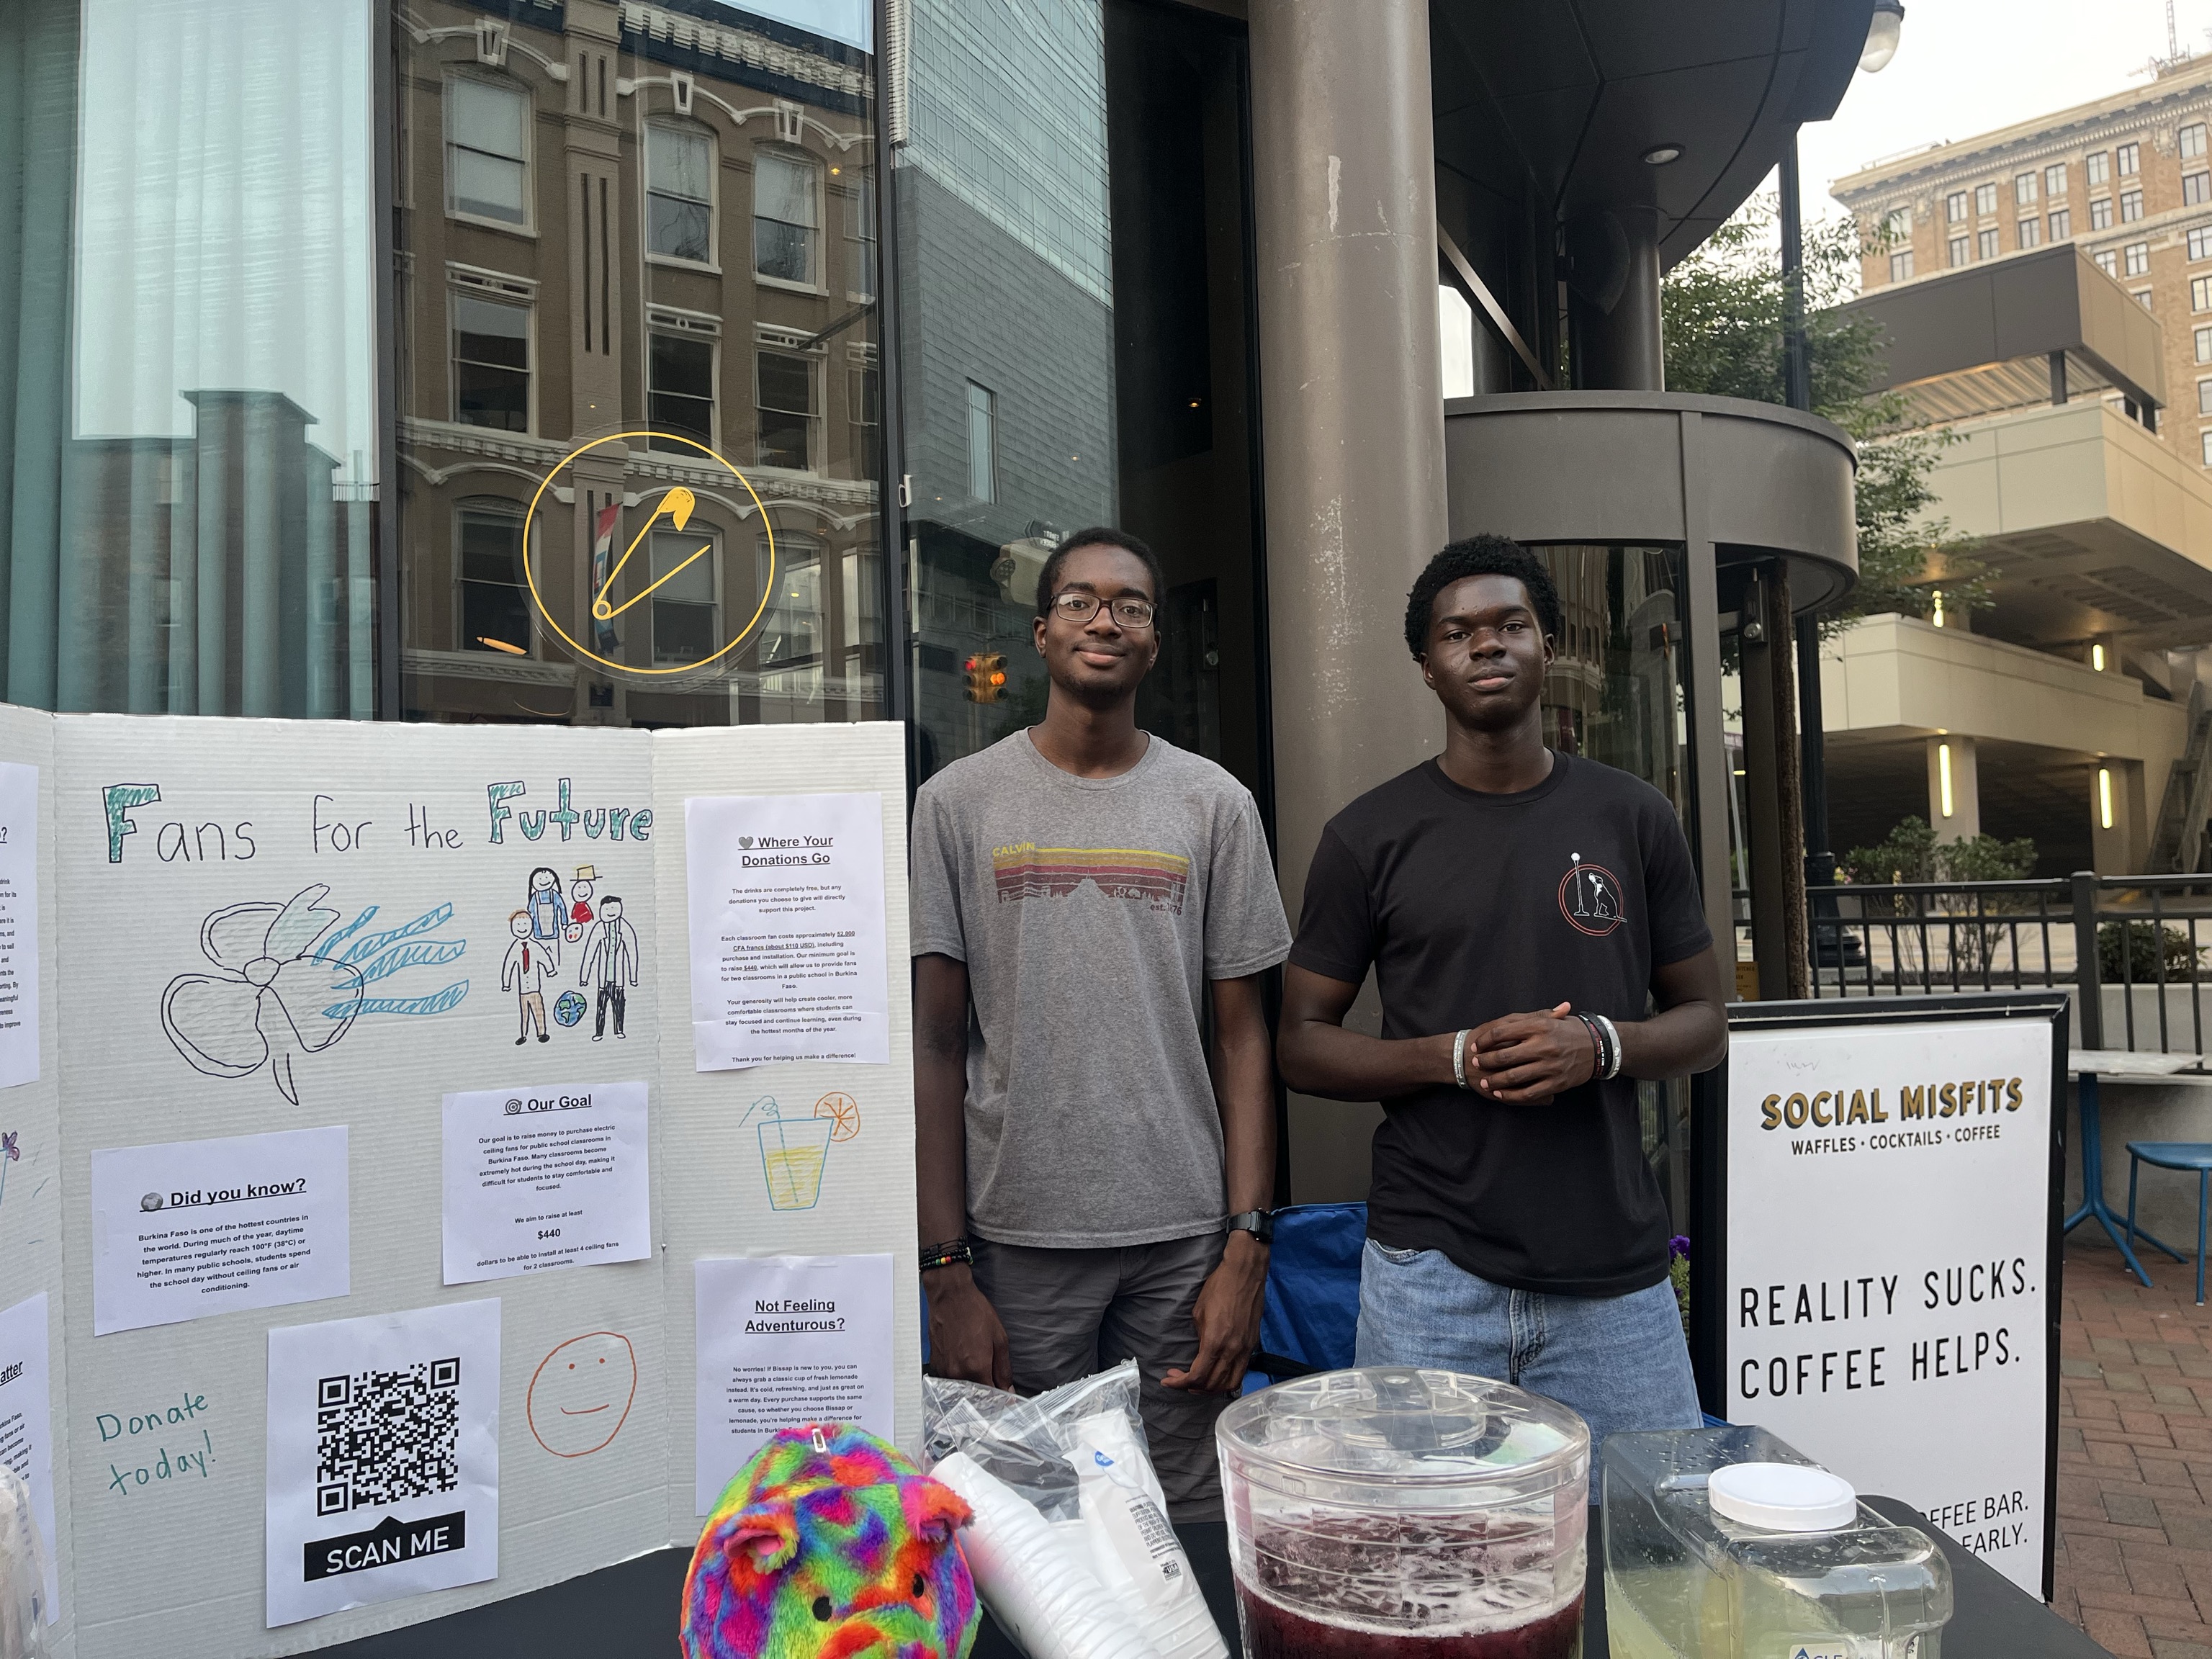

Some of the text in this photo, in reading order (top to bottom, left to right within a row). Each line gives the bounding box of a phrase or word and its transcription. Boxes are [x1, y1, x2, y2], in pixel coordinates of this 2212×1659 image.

[102, 783, 256, 863] Fans
[404, 803, 464, 848] the
[487, 778, 654, 844] Future
[758, 835, 833, 848] Where Your
[992, 842, 1036, 857] CALVIN
[742, 853, 830, 866] Donations Go
[528, 1094, 591, 1110] Our Goal
[1761, 1076, 2023, 1130] SOCIAL MISFITS
[1791, 1125, 2000, 1156] WAFFLES COCKTAILS COFFEE
[479, 1168, 510, 1177] extremely
[565, 1168, 601, 1177] comfortable
[171, 1178, 307, 1206] Did you know?
[138, 1233, 168, 1241] Burkina
[238, 1220, 264, 1228] hottest
[266, 1216, 300, 1225] countries
[538, 1228, 561, 1240] $440
[157, 1242, 181, 1251] world.
[256, 1231, 274, 1240] year,
[142, 1254, 192, 1265] temperatures
[194, 1249, 228, 1259] regularly
[197, 1262, 220, 1272] public
[222, 1257, 253, 1267] schools,
[255, 1253, 287, 1262] students
[288, 1249, 310, 1258] spend
[539, 1259, 575, 1268] classrooms.
[163, 1277, 189, 1286] school
[206, 1271, 235, 1280] without
[201, 1282, 250, 1293] conditioning.
[1740, 1257, 2036, 1328] REALITY SUCKS.
[755, 1299, 835, 1313] Not Feeling
[745, 1318, 845, 1332] Adventurous?
[0, 1362, 22, 1382] atter
[1740, 1328, 2020, 1399] COFFEE HELPS.
[96, 1392, 209, 1442] Donate
[109, 1430, 217, 1496] today!
[1919, 1491, 2028, 1529] FFEE BAR.
[1962, 1522, 2027, 1555] EARLY.
[325, 1527, 449, 1573] SCAN ME
[1167, 1563, 1179, 1573] USA
